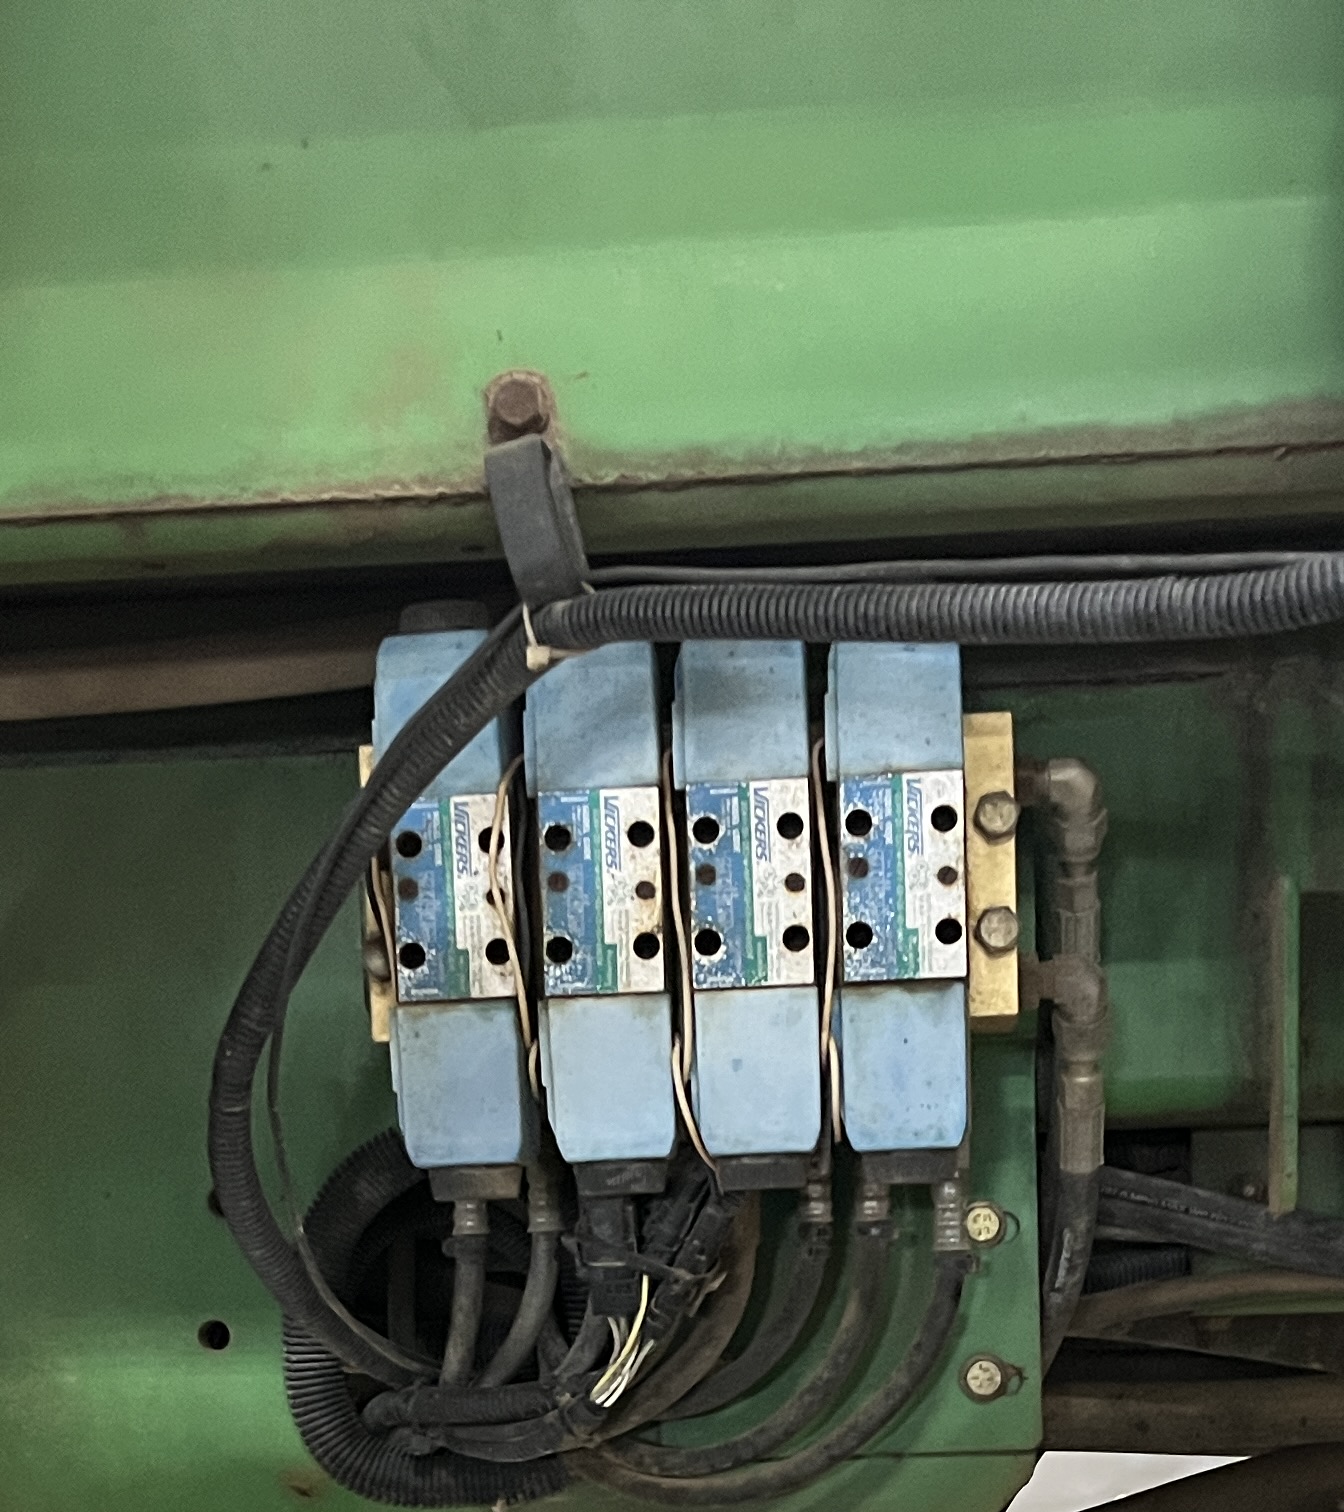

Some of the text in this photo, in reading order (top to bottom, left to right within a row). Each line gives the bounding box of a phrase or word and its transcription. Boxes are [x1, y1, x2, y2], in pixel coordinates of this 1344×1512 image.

[453, 801, 473, 876] VICKERS
[603, 795, 622, 871] VICKERS
[753, 787, 772, 862] VICKERS
[905, 778, 924, 855] VICKERS
